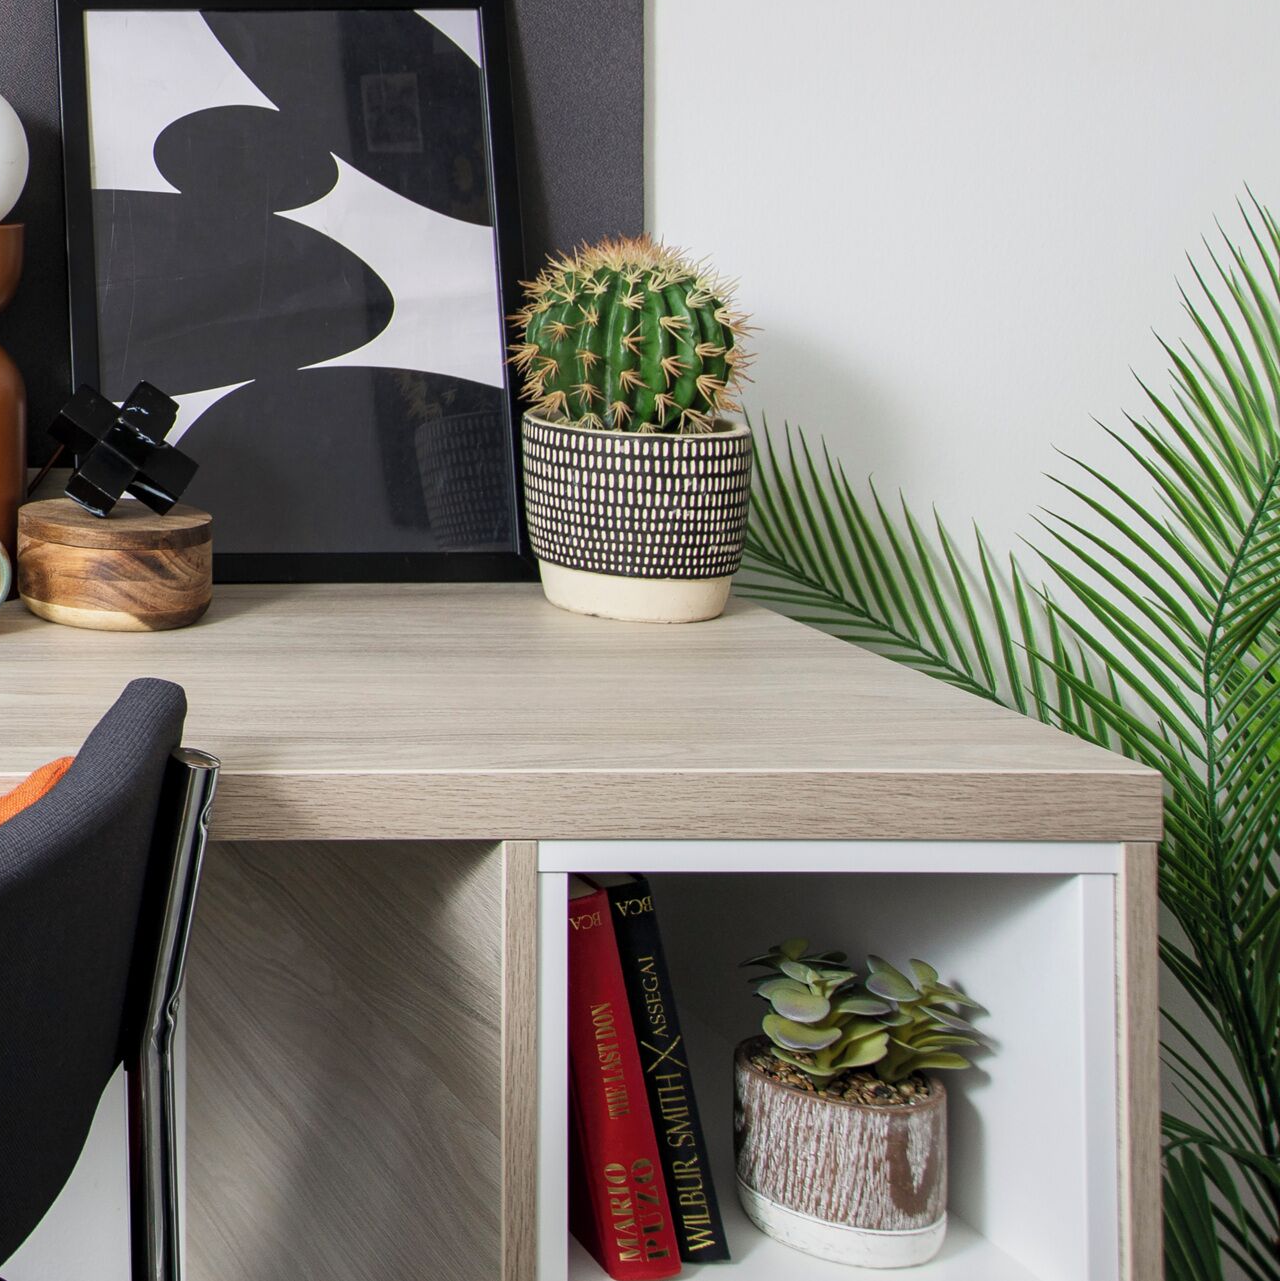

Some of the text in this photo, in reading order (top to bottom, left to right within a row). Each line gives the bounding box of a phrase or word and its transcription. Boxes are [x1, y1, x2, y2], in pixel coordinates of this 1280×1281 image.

[569, 911, 602, 931] BCA
[615, 895, 654, 917] BCA
[638, 956, 669, 1038] ASSEGAI
[590, 1002, 631, 1120] THE LAST DON
[631, 1158, 670, 1262] PUZO
[655, 1073, 716, 1252] WILBUR SMITH
[603, 1163, 643, 1262] MARIO
